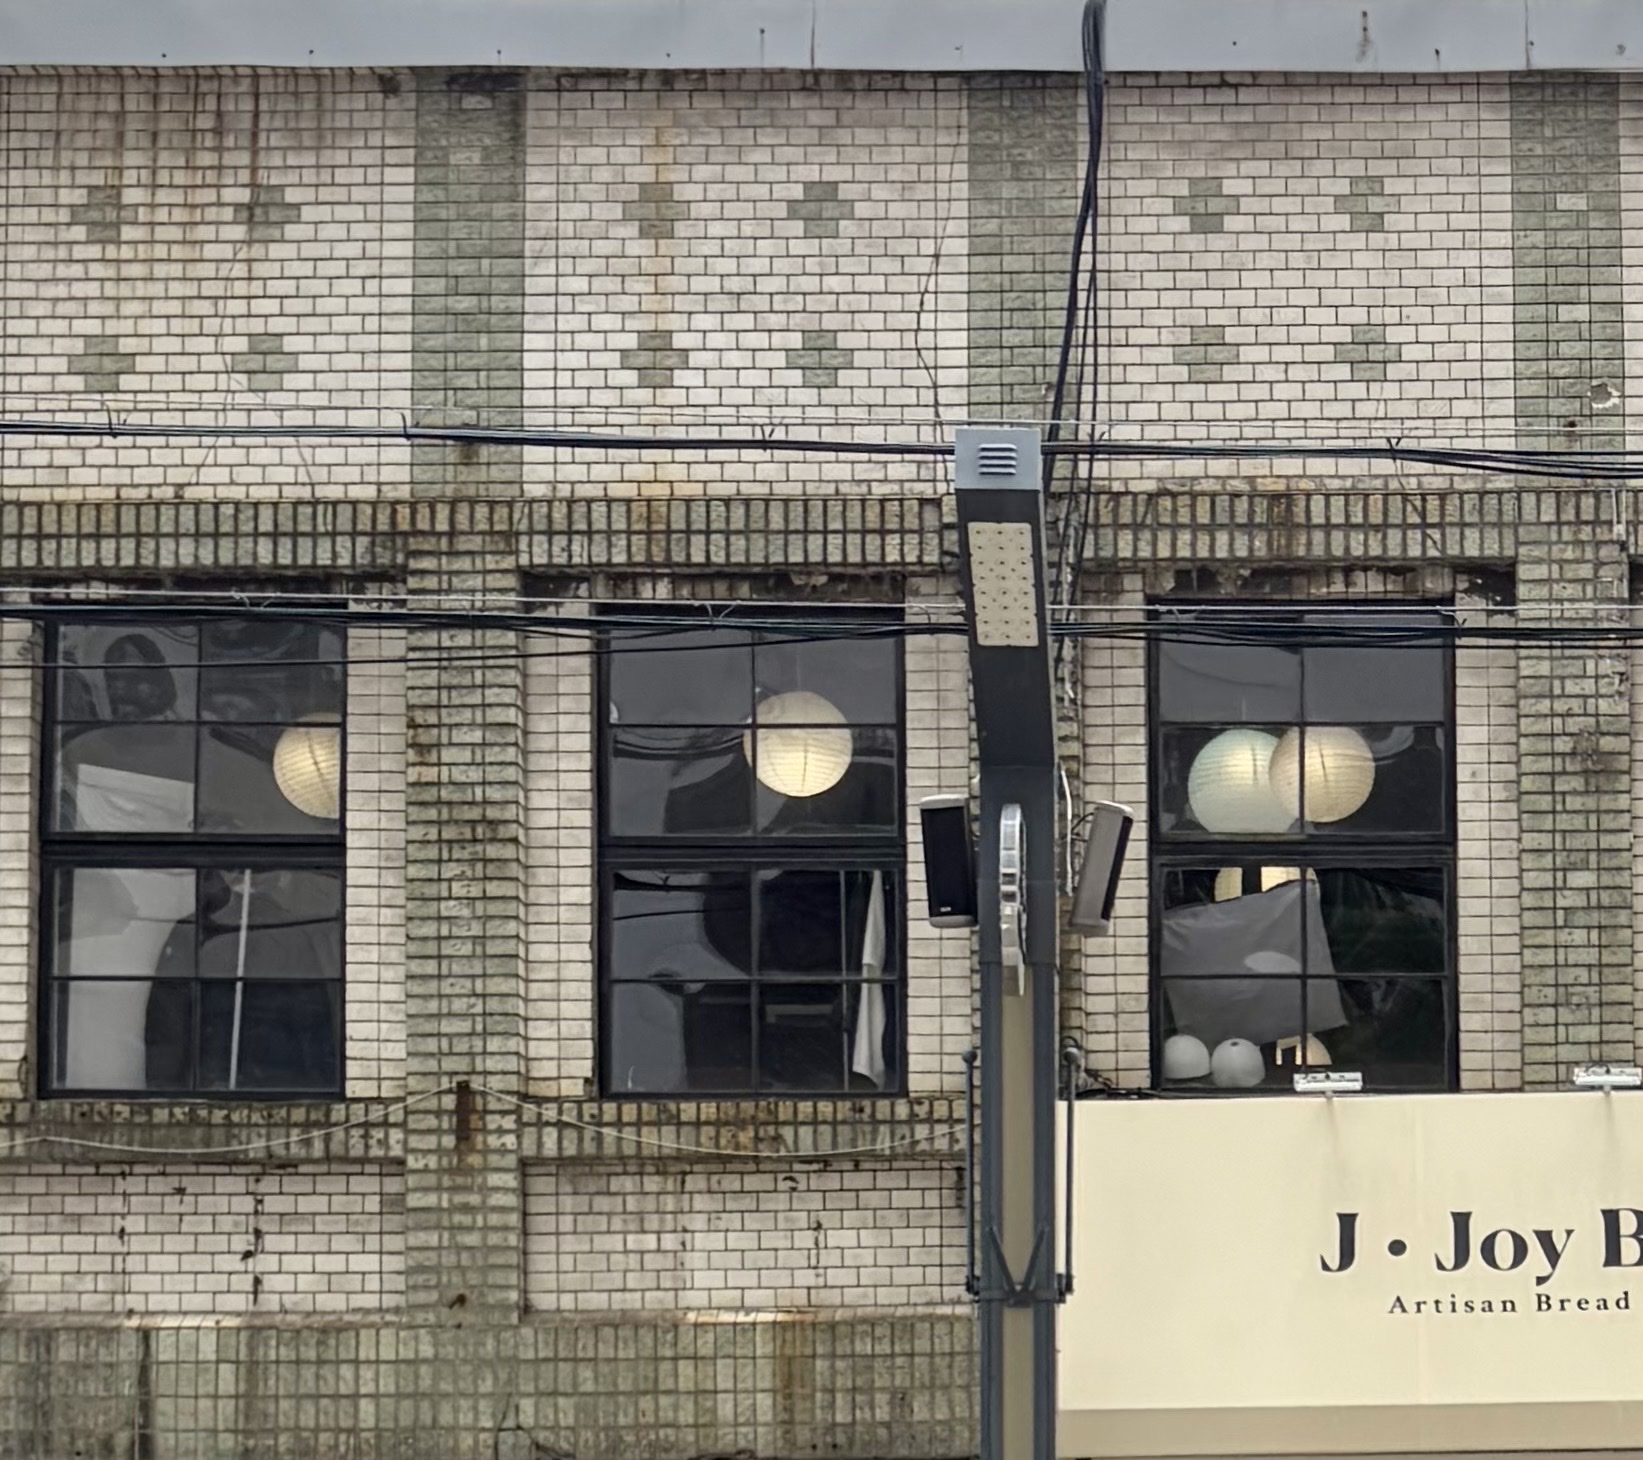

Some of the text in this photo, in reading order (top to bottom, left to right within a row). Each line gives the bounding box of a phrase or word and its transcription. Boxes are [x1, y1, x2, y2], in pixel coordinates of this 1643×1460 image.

[1319, 1211, 1360, 1273] J
[1435, 1210, 1575, 1286] Joy
[1388, 1294, 1519, 1315] Artisan
[1536, 1290, 1631, 1312] Bread
